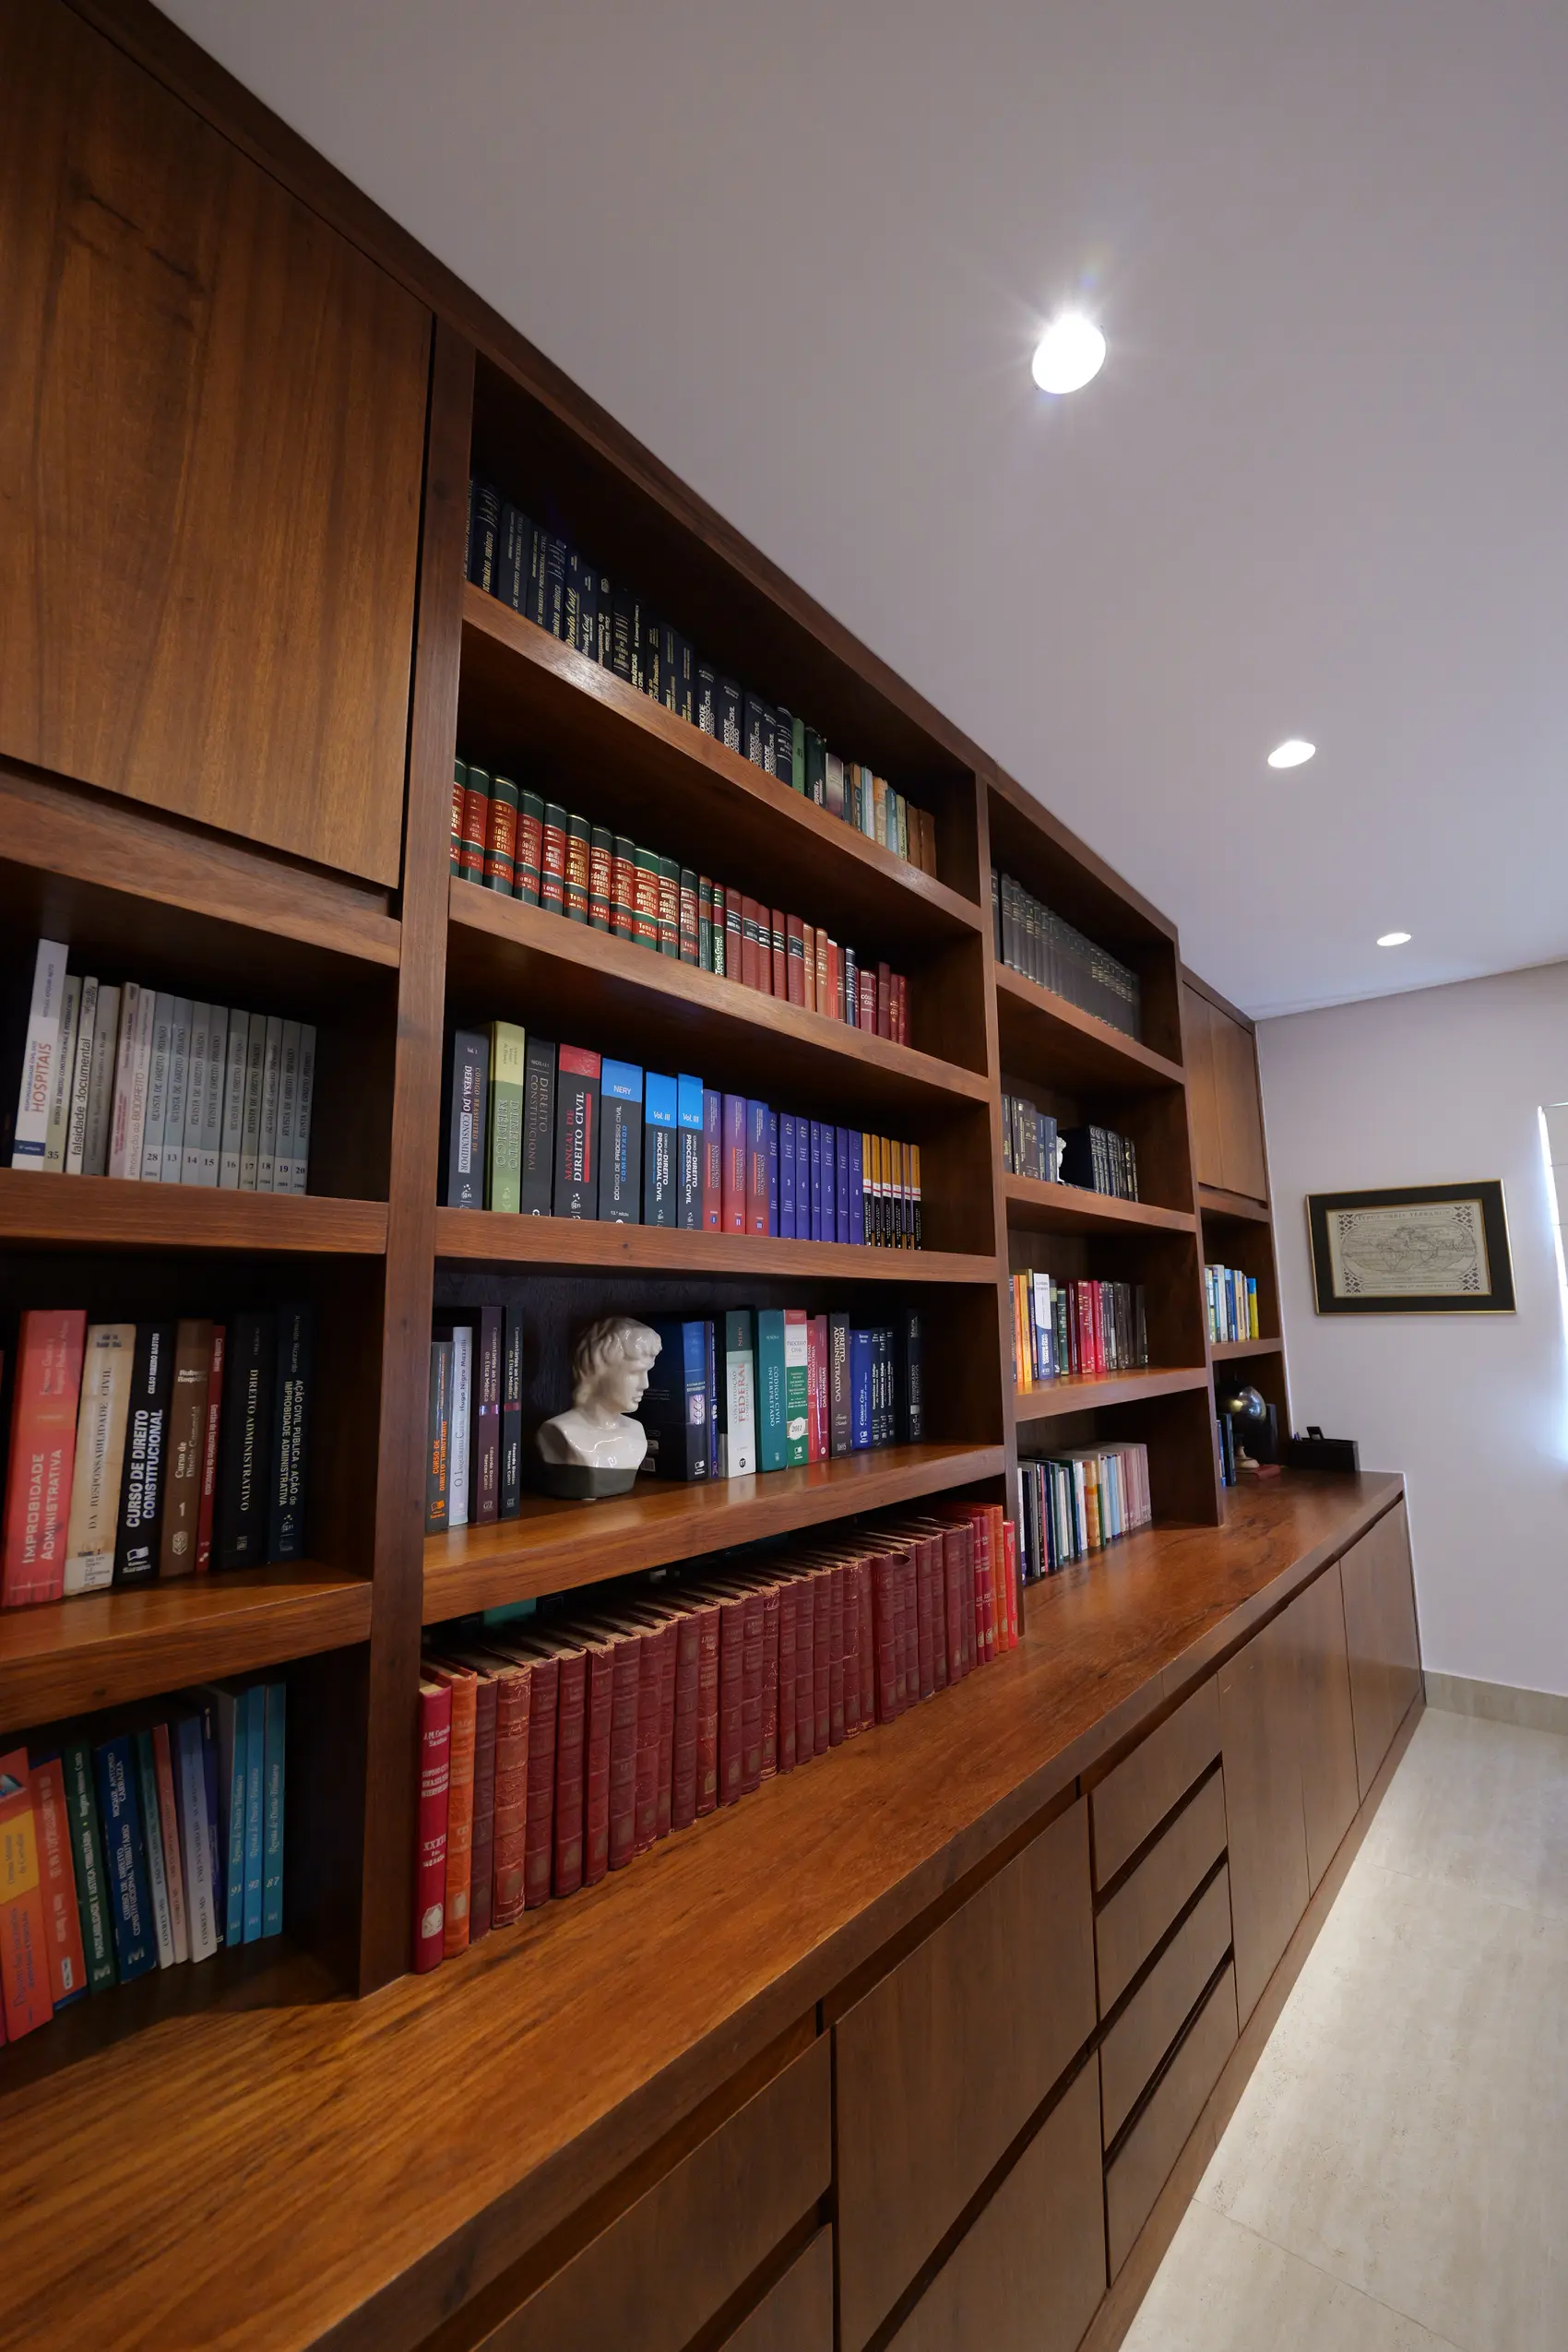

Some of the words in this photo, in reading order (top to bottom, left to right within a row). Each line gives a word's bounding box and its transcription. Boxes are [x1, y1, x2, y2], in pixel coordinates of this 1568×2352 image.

[156, 1026, 167, 1052] PRIVADO
[174, 1028, 184, 1054] PRIVADO
[32, 1043, 52, 1113] HOSPITAIS
[75, 1039, 91, 1102] documental
[154, 1056, 164, 1081] DIREITO
[173, 1058, 183, 1082] DIREITO
[462, 1065, 472, 1095] DEFESA
[153, 1083, 162, 1092] DE
[172, 1085, 181, 1094] DE
[614, 1085, 631, 1095] NERY
[151, 1095, 161, 1121] REVISTA
[170, 1097, 181, 1122] REVISTA
[462, 1098, 471, 1111] DO
[539, 1077, 549, 1132] DIREITO
[566, 1109, 575, 1125] DE
[575, 1091, 585, 1124] CIVIL
[69, 1106, 85, 1155] falsidade
[471, 1099, 480, 1138] BRASILEIRO
[460, 1114, 469, 1170] CONSUMIDOR
[496, 1099, 508, 1167] MÉDICO
[508, 1099, 519, 1169] DIREITO
[48, 1150, 59, 1160] 35
[147, 1153, 158, 1161] 28
[167, 1154, 177, 1162] 13
[187, 1156, 197, 1164] 14
[227, 1160, 236, 1168] 16
[564, 1129, 574, 1180] MANUAL
[573, 1129, 584, 1181] DIREITO
[615, 1162, 620, 1171] DE
[280, 1165, 288, 1173] 19
[150, 1334, 159, 1354] BASTOS
[509, 1350, 513, 1358] de
[148, 1355, 157, 1375] RIBEIRO
[100, 1367, 111, 1395] CIVIL
[147, 1376, 156, 1394] CELSO
[246, 1369, 258, 1414] DIREITO
[292, 1380, 304, 1402] AÇÃO
[282, 1381, 292, 1436] IMPROBIDADE
[293, 1404, 302, 1425] CIVIL
[131, 1410, 148, 1458] DIREITO
[176, 1442, 186, 1451] de
[291, 1427, 302, 1461] PÚBLICA
[433, 1439, 440, 1448] DE
[90, 1402, 108, 1505] RESPONSABILIDADE
[142, 1409, 163, 1518] CONSTITUCIONAL
[174, 1453, 185, 1478] Curso
[240, 1416, 255, 1510] ADMINISTRATIVO
[129, 1463, 145, 1479] DE
[279, 1438, 290, 1505] ADMINISTRATIVA
[287, 1470, 299, 1493] AÇÃO
[455, 1478, 462, 1486] O
[22, 1453, 45, 1563] IMPROBIDADE
[40, 1449, 62, 1559] ADMINISTRATIVA
[126, 1483, 143, 1527] CURSO
[179, 1502, 186, 1517] 1
[289, 1496, 297, 1505] de
[88, 1515, 97, 1529] DA
[115, 1760, 126, 1801] CARRAZZA
[110, 1790, 120, 1817] ROQUE
[121, 1824, 133, 1868] TRIBUTÁRIO
[116, 1847, 127, 1879] DIREITO
[119, 1881, 129, 1892] DE
[230, 1883, 241, 1896] 91
[247, 1879, 259, 1891] 92
[266, 1876, 280, 1888] 87
[120, 1892, 132, 1920] CURSO
[126, 1869, 140, 1935] CONSTITUCIONAL
